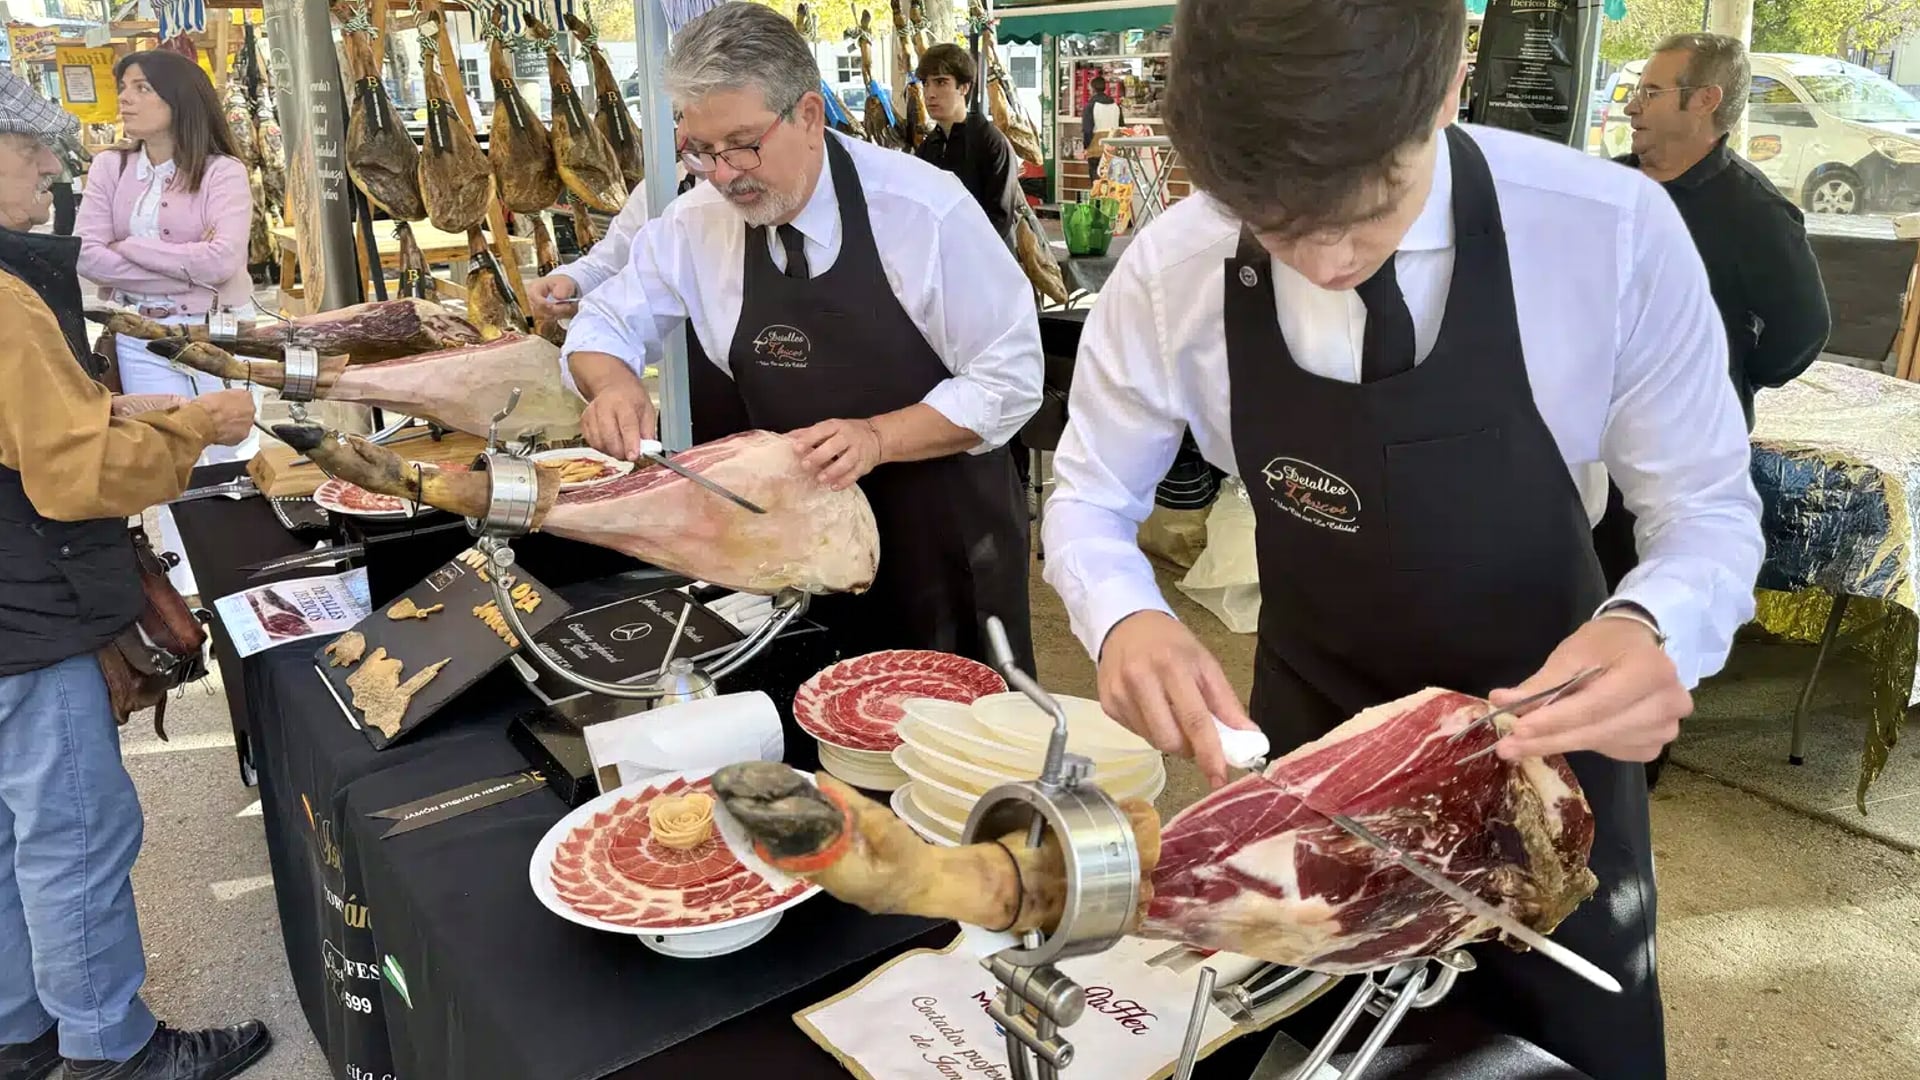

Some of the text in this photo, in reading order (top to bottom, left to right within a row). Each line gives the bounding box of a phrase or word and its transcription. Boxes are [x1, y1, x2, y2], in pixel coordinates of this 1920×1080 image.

[1283, 465, 1348, 496] Detalles
[403, 804, 439, 821] JAMÓN
[345, 991, 372, 1014] 599
[911, 996, 966, 1048] Cortador
[909, 1034, 935, 1050] de
